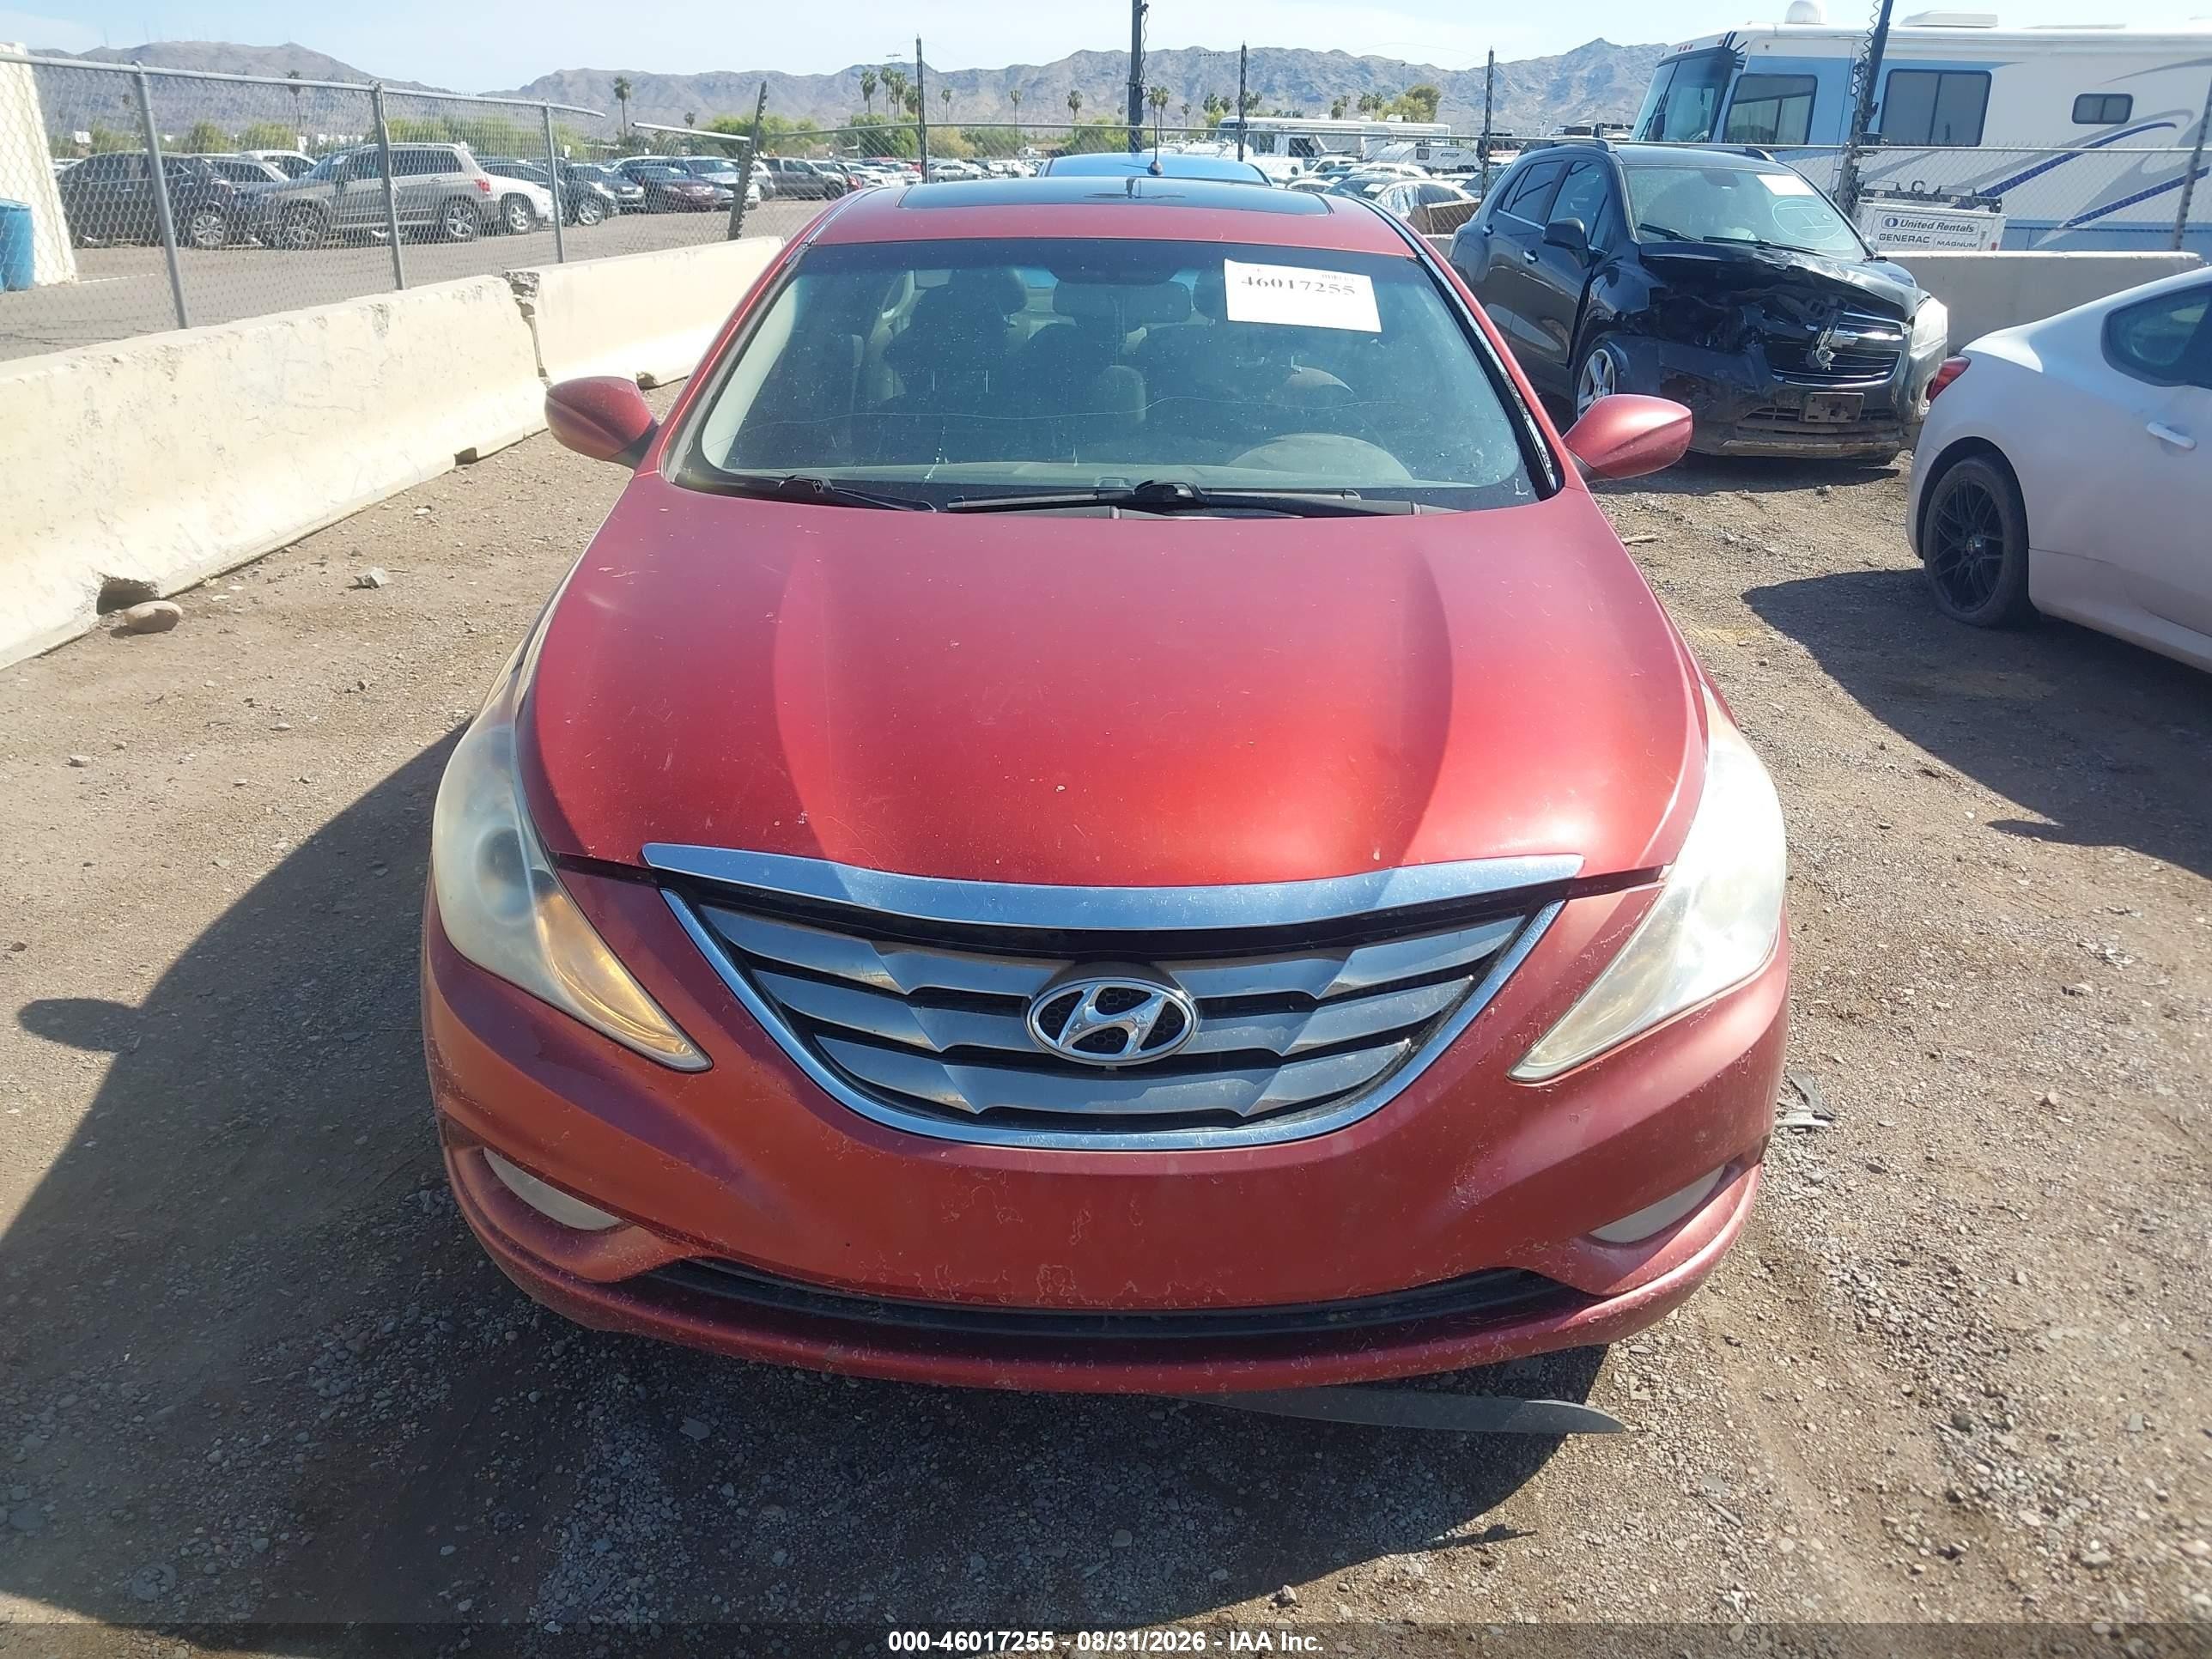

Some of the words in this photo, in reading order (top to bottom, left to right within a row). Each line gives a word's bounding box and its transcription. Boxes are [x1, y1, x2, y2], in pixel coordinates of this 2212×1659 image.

[1900, 219, 1933, 230] United
[1936, 222, 1974, 233] Rentals
[1879, 233, 1930, 244] GENERAC
[1936, 240, 1978, 248] MAGNUM
[1241, 276, 1356, 295] 46017255
